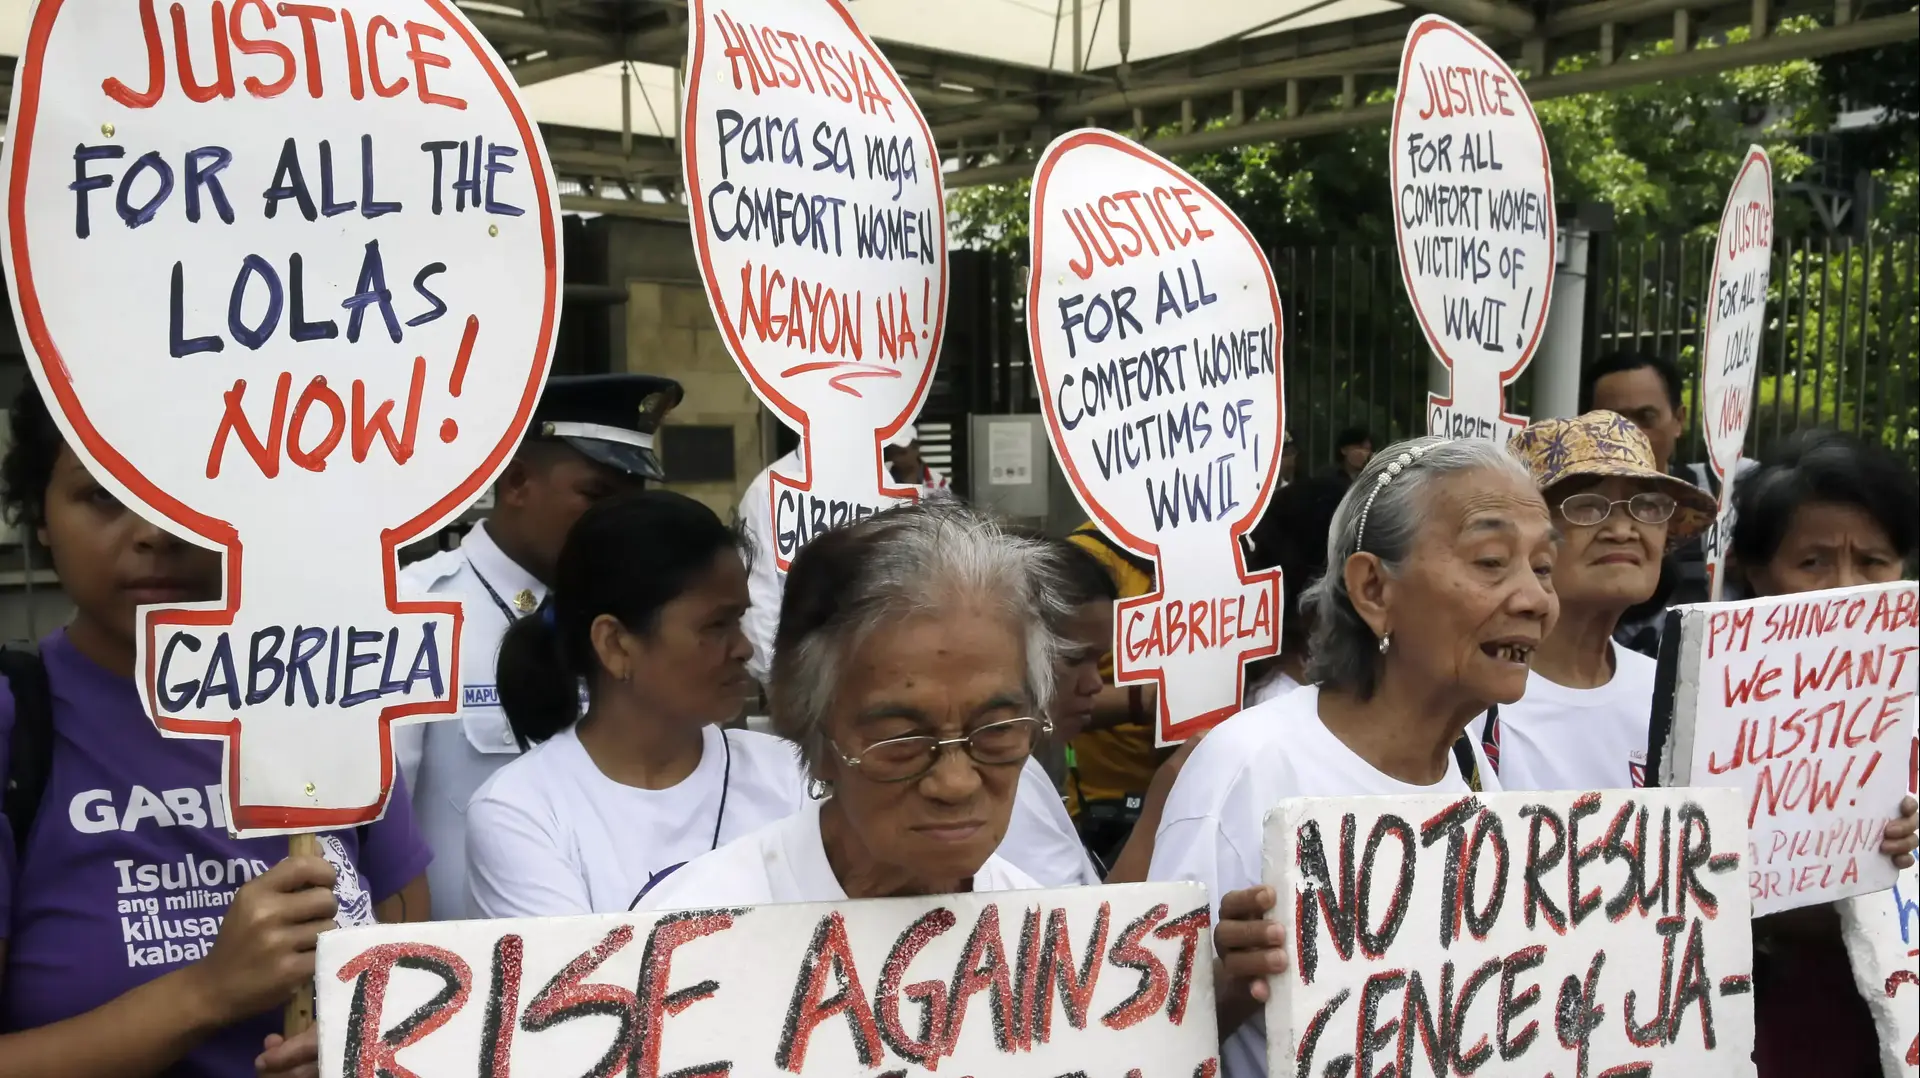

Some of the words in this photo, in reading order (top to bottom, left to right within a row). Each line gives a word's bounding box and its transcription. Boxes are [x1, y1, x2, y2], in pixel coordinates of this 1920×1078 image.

[102, 0, 468, 110] JUSTICE
[713, 9, 895, 123] HUSTISYA
[1419, 62, 1515, 120] JUSTICE
[68, 142, 234, 239] FOR
[262, 134, 402, 222] ALL
[420, 135, 526, 216] THE
[813, 121, 855, 179] sa
[865, 135, 917, 201] mga
[1407, 133, 1453, 179] FOR
[1459, 129, 1503, 173] ALL
[708, 181, 846, 257] COMFORT
[854, 203, 934, 265] WOMEN
[1062, 186, 1214, 280] JUSTICE
[1401, 182, 1483, 231] COMFORT
[1489, 187, 1546, 240] WOMEN
[1729, 201, 1770, 260] JUSTICE
[169, 239, 449, 358] LOLAS
[1414, 235, 1491, 284] VICTIMS
[1499, 247, 1525, 289] OF
[1716, 274, 1739, 322] FOR
[1738, 268, 1755, 314] ALL
[739, 260, 862, 361] NGAYON
[1058, 286, 1143, 358] FOR
[1156, 259, 1217, 325] ALL
[206, 315, 479, 479] NOW!
[1058, 344, 1187, 430] COMFORT
[1193, 323, 1274, 389] WOMEN
[1092, 401, 1212, 481] VICTIMS
[1223, 399, 1254, 449] OF
[777, 490, 880, 556] GABR
[1126, 588, 1270, 662] GABRIELA
[1708, 606, 1754, 659] PM
[1761, 598, 1866, 644] SHINZO
[156, 621, 445, 712] GABRIELA
[1792, 643, 1919, 699] WANT
[1708, 691, 1914, 774] JUSTICE
[1748, 751, 1882, 830] NOW!
[117, 897, 159, 915] ang
[166, 888, 239, 910] militan
[1296, 813, 1416, 985] NO
[1420, 795, 1509, 950] TO
[1518, 791, 1741, 936] RESUR-
[1749, 856, 1858, 900] BRIELA
[336, 906, 755, 1078] RISE
[774, 901, 1210, 1074] AGAINST
